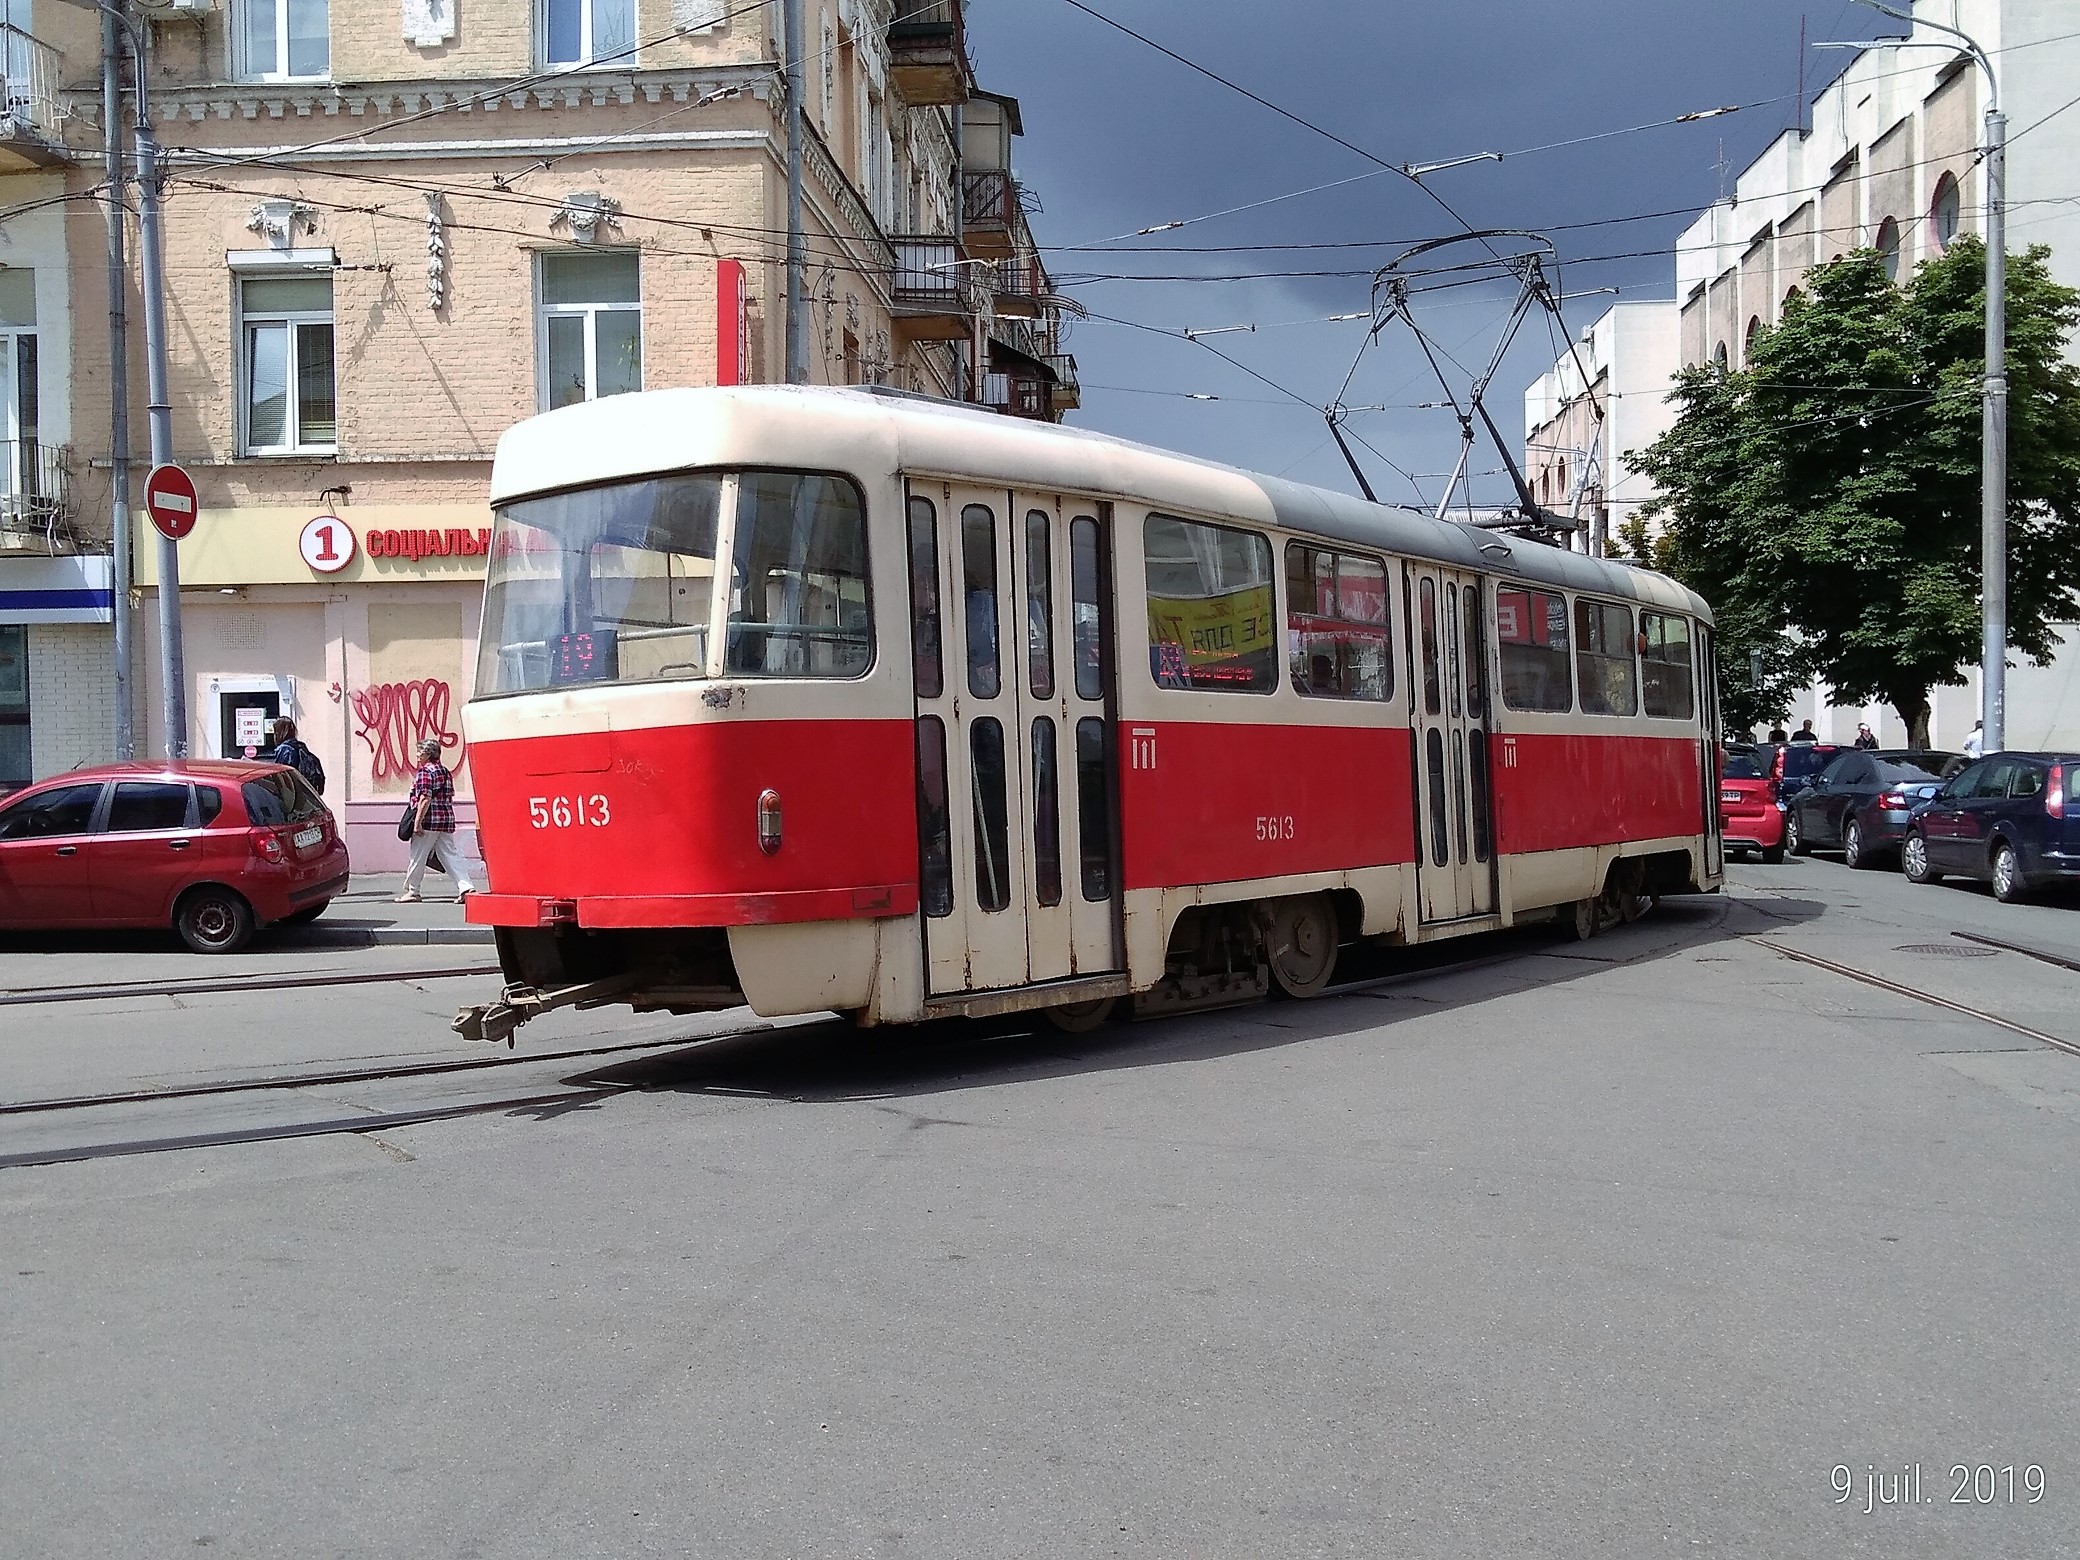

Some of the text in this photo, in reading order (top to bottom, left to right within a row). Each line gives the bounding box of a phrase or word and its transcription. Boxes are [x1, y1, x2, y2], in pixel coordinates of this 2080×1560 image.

[314, 525, 339, 561] 1
[529, 794, 611, 829] 5613
[1256, 815, 1294, 841] 5613
